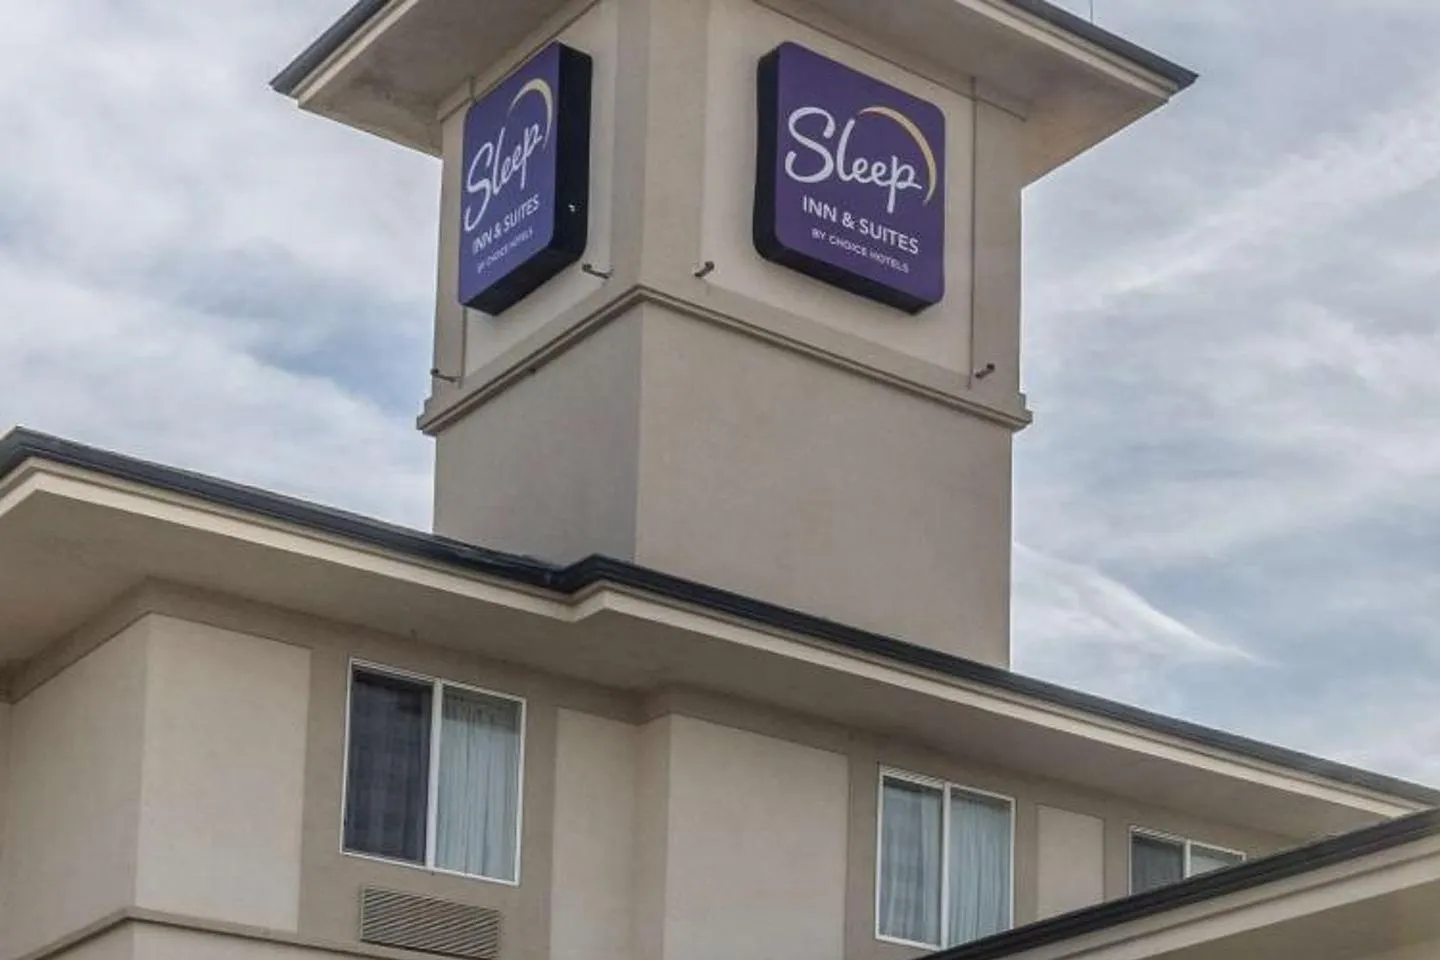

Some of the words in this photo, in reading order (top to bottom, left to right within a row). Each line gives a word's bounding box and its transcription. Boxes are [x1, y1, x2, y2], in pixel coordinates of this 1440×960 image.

[464, 123, 543, 232] Sleep
[785, 107, 923, 214] Sleep
[503, 194, 540, 233] SUITES
[803, 194, 838, 223] INN
[842, 211, 855, 230] &
[859, 218, 919, 255] SUITES
[828, 235, 868, 257] CHOICE
